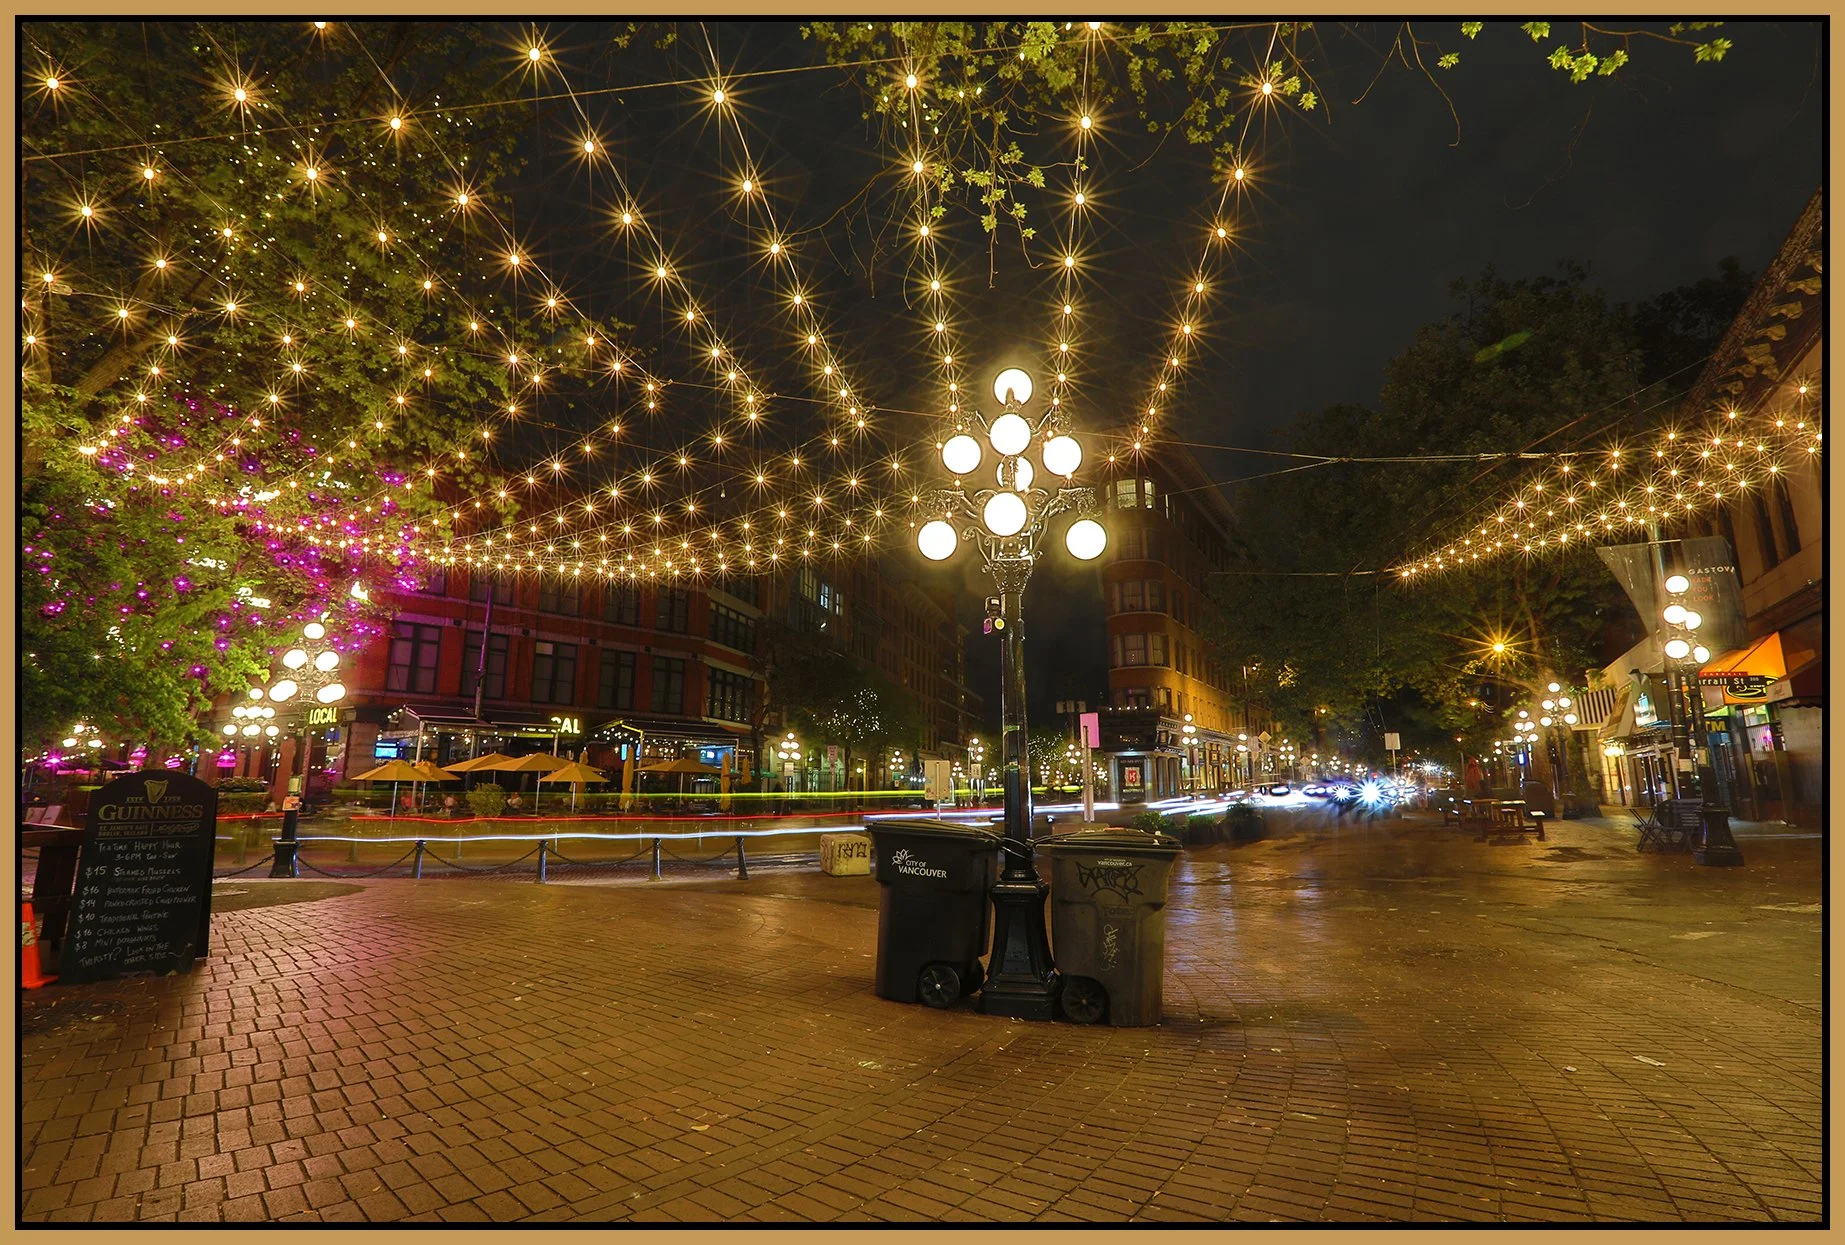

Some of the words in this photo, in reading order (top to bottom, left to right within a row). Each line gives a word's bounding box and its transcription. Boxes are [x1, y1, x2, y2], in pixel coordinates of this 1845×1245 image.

[1733, 677, 1744, 685] St
[309, 707, 337, 724] LOCAL
[98, 804, 203, 821] GUINNESS
[85, 865, 107, 879] $15
[898, 865, 948, 879] VANCOUVER
